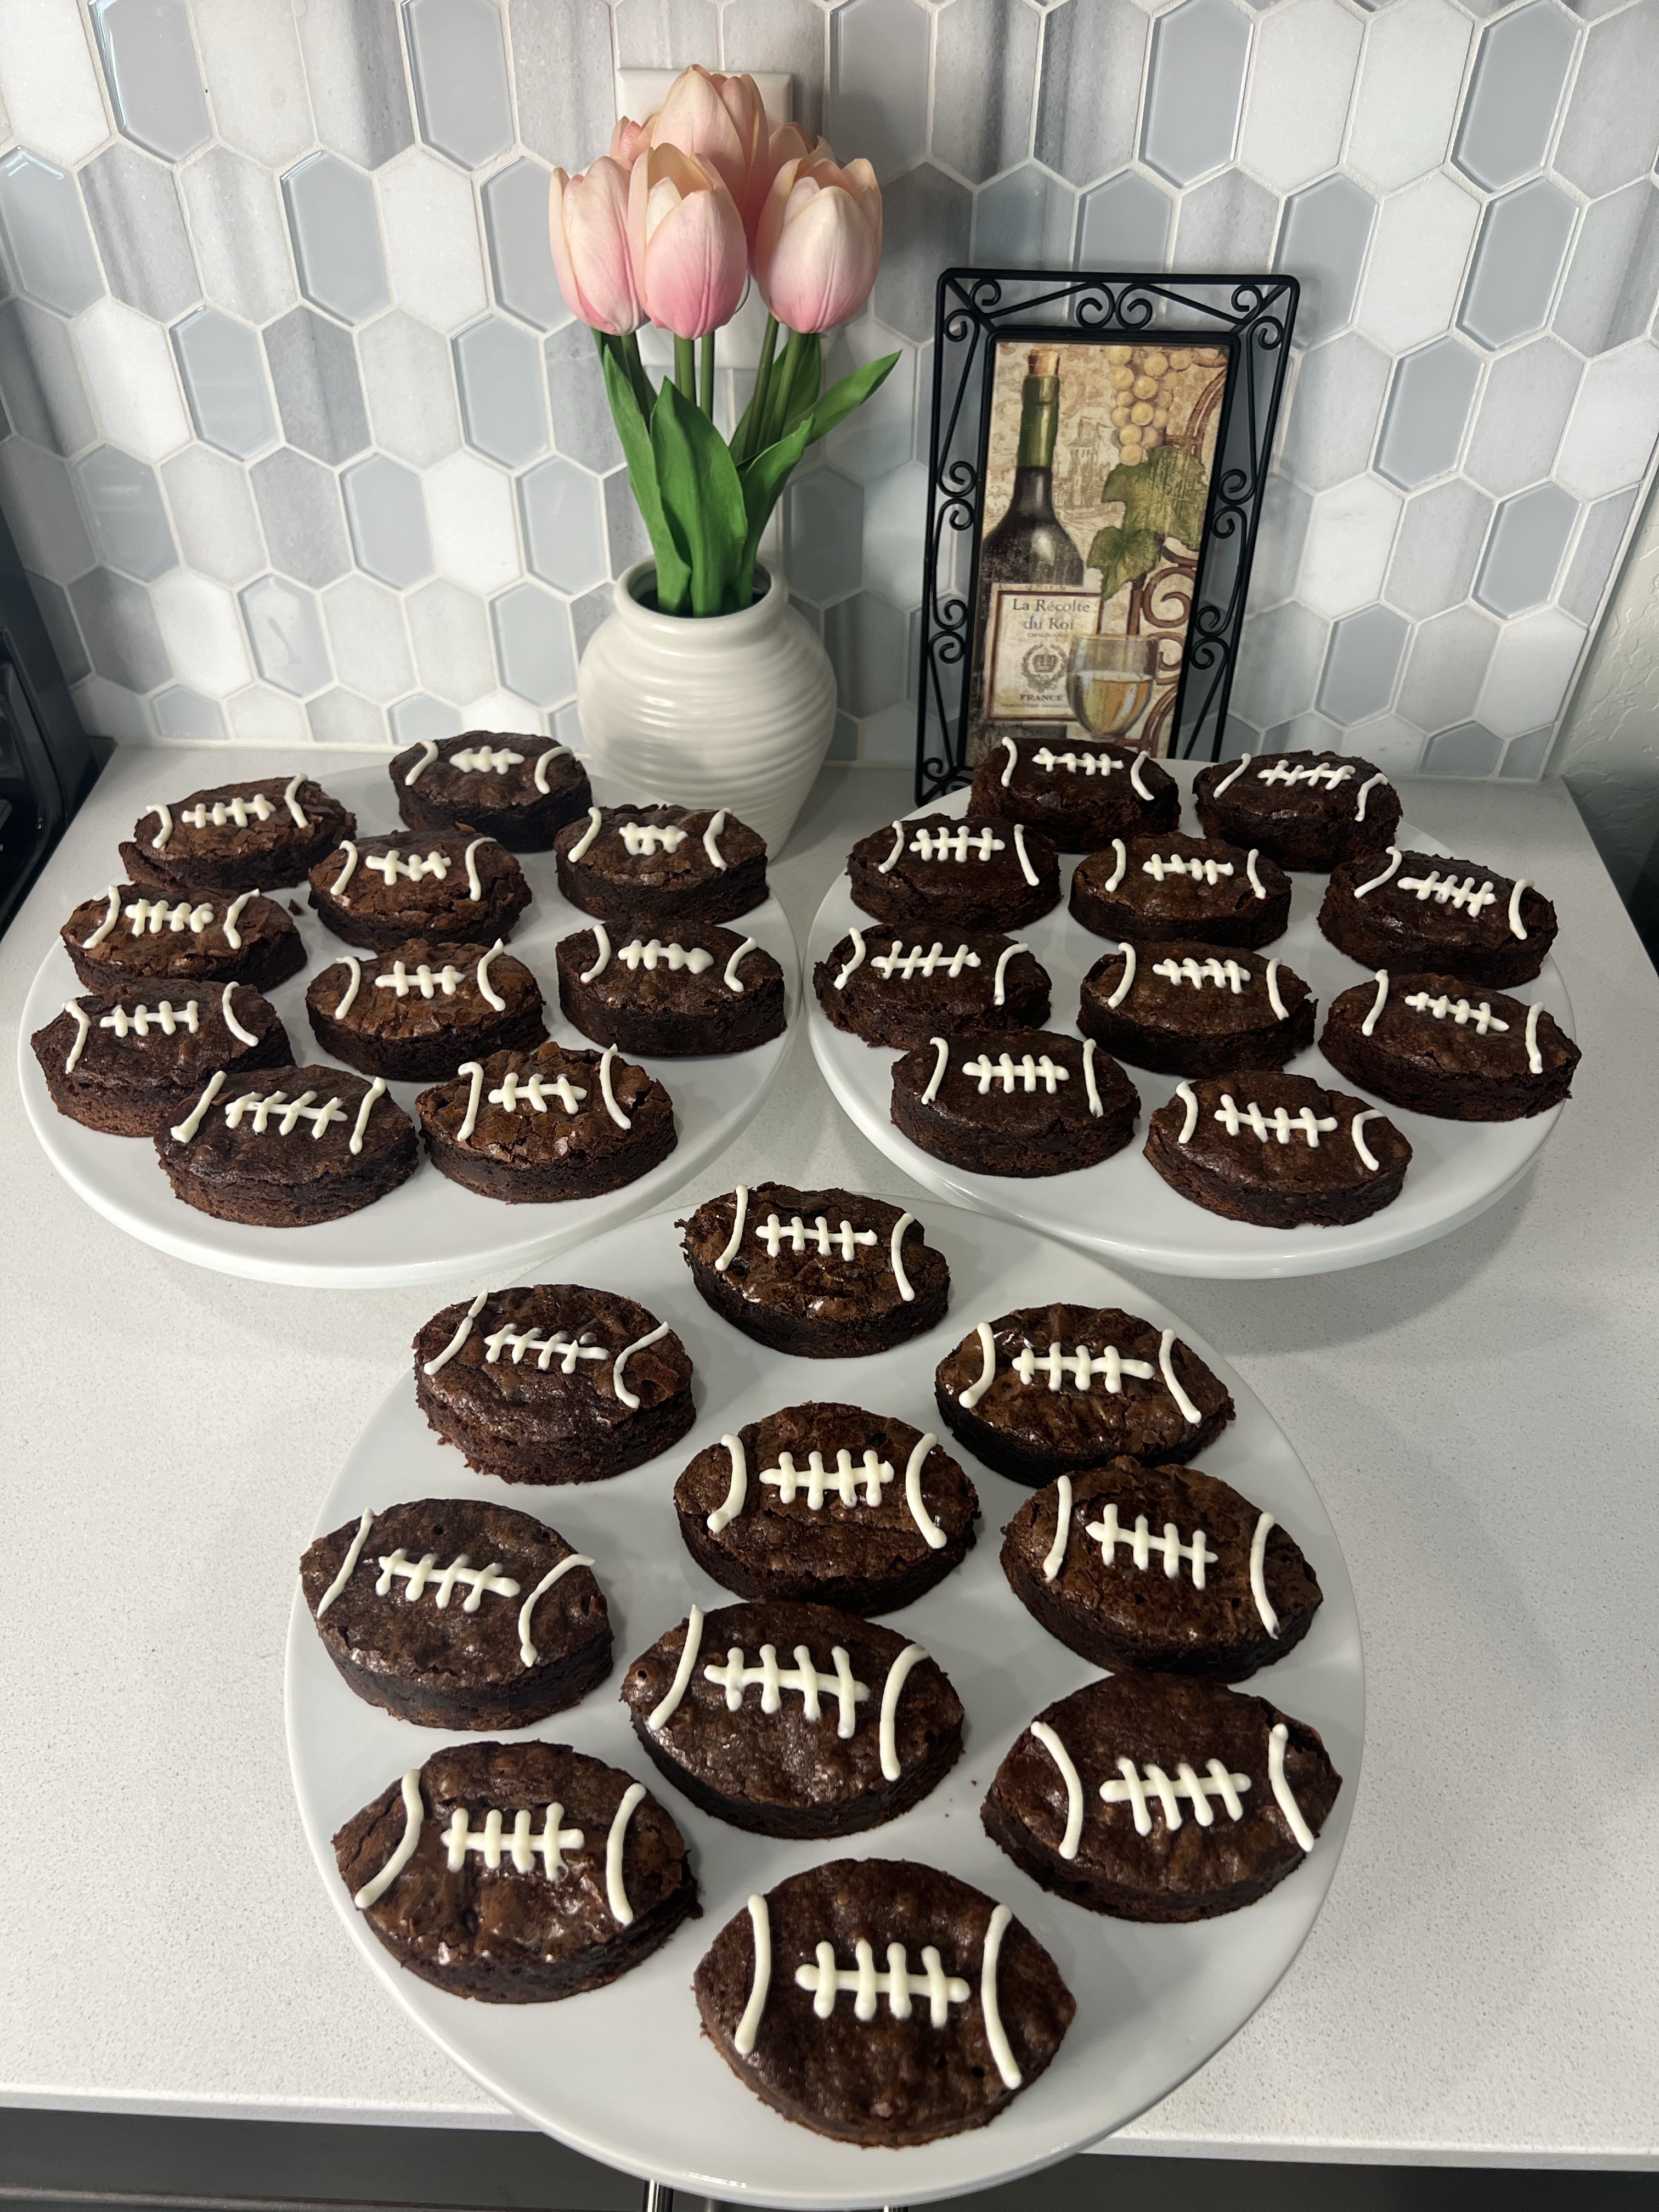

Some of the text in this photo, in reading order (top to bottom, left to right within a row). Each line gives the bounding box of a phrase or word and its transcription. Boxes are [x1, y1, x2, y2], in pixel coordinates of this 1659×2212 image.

[1013, 599, 1090, 612] La Récolte
[1023, 615, 1074, 630] du Roi
